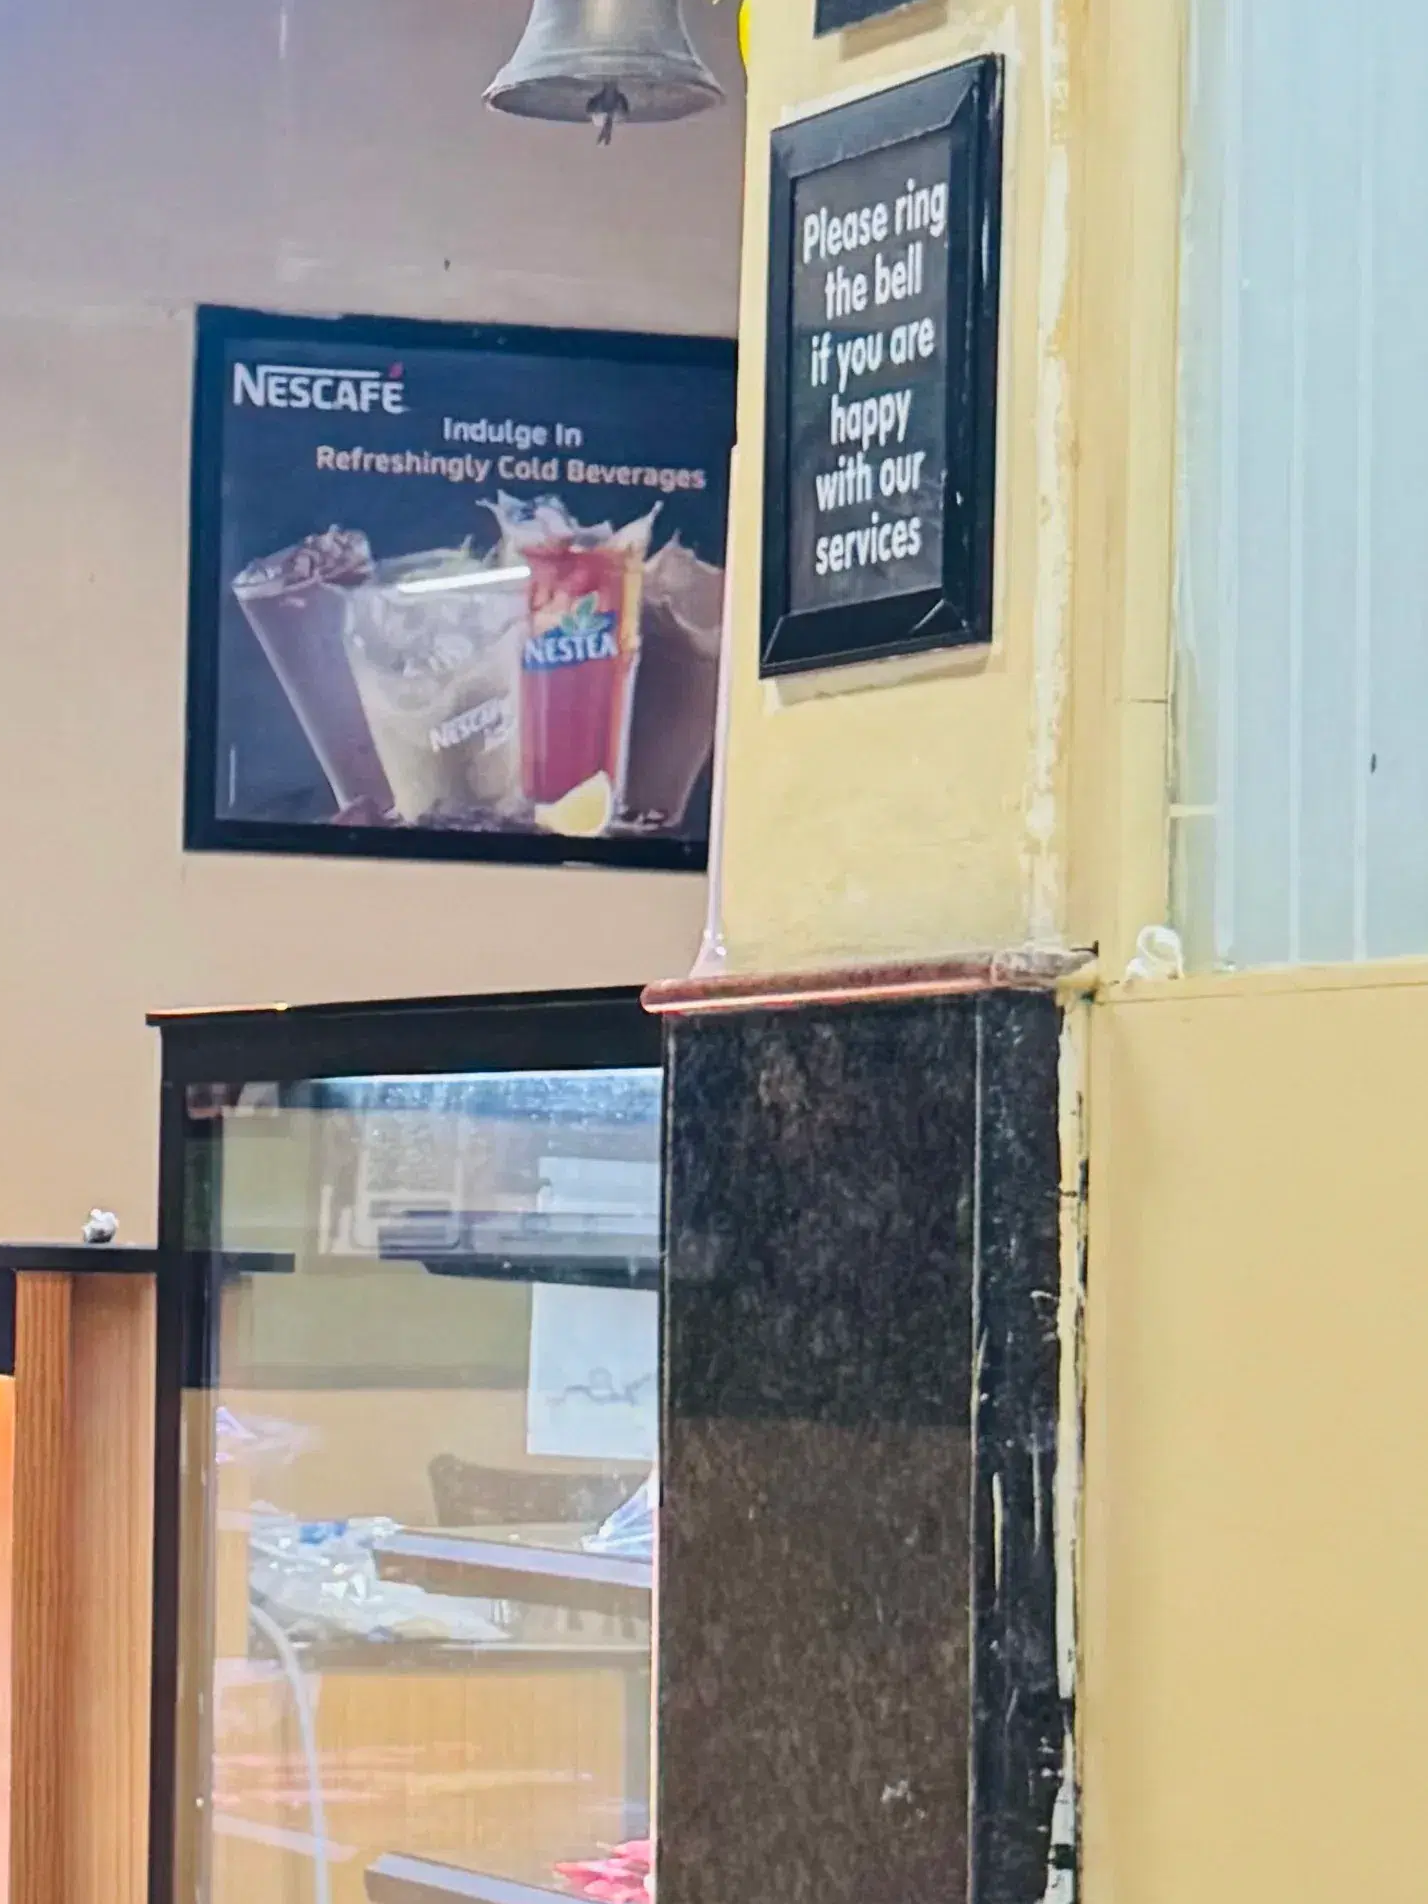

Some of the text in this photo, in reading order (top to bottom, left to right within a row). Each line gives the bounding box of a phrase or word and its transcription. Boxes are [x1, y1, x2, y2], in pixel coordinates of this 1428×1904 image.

[802, 176, 949, 264] Please ring
[824, 242, 923, 321] the bell
[809, 315, 936, 393] if you are
[443, 416, 583, 448] Indulge In
[829, 387, 913, 452] happy
[315, 444, 707, 492] Refreshingly Cold Beverages
[815, 446, 927, 512] with our
[814, 511, 923, 577] services
[524, 634, 619, 666] NESTEA
